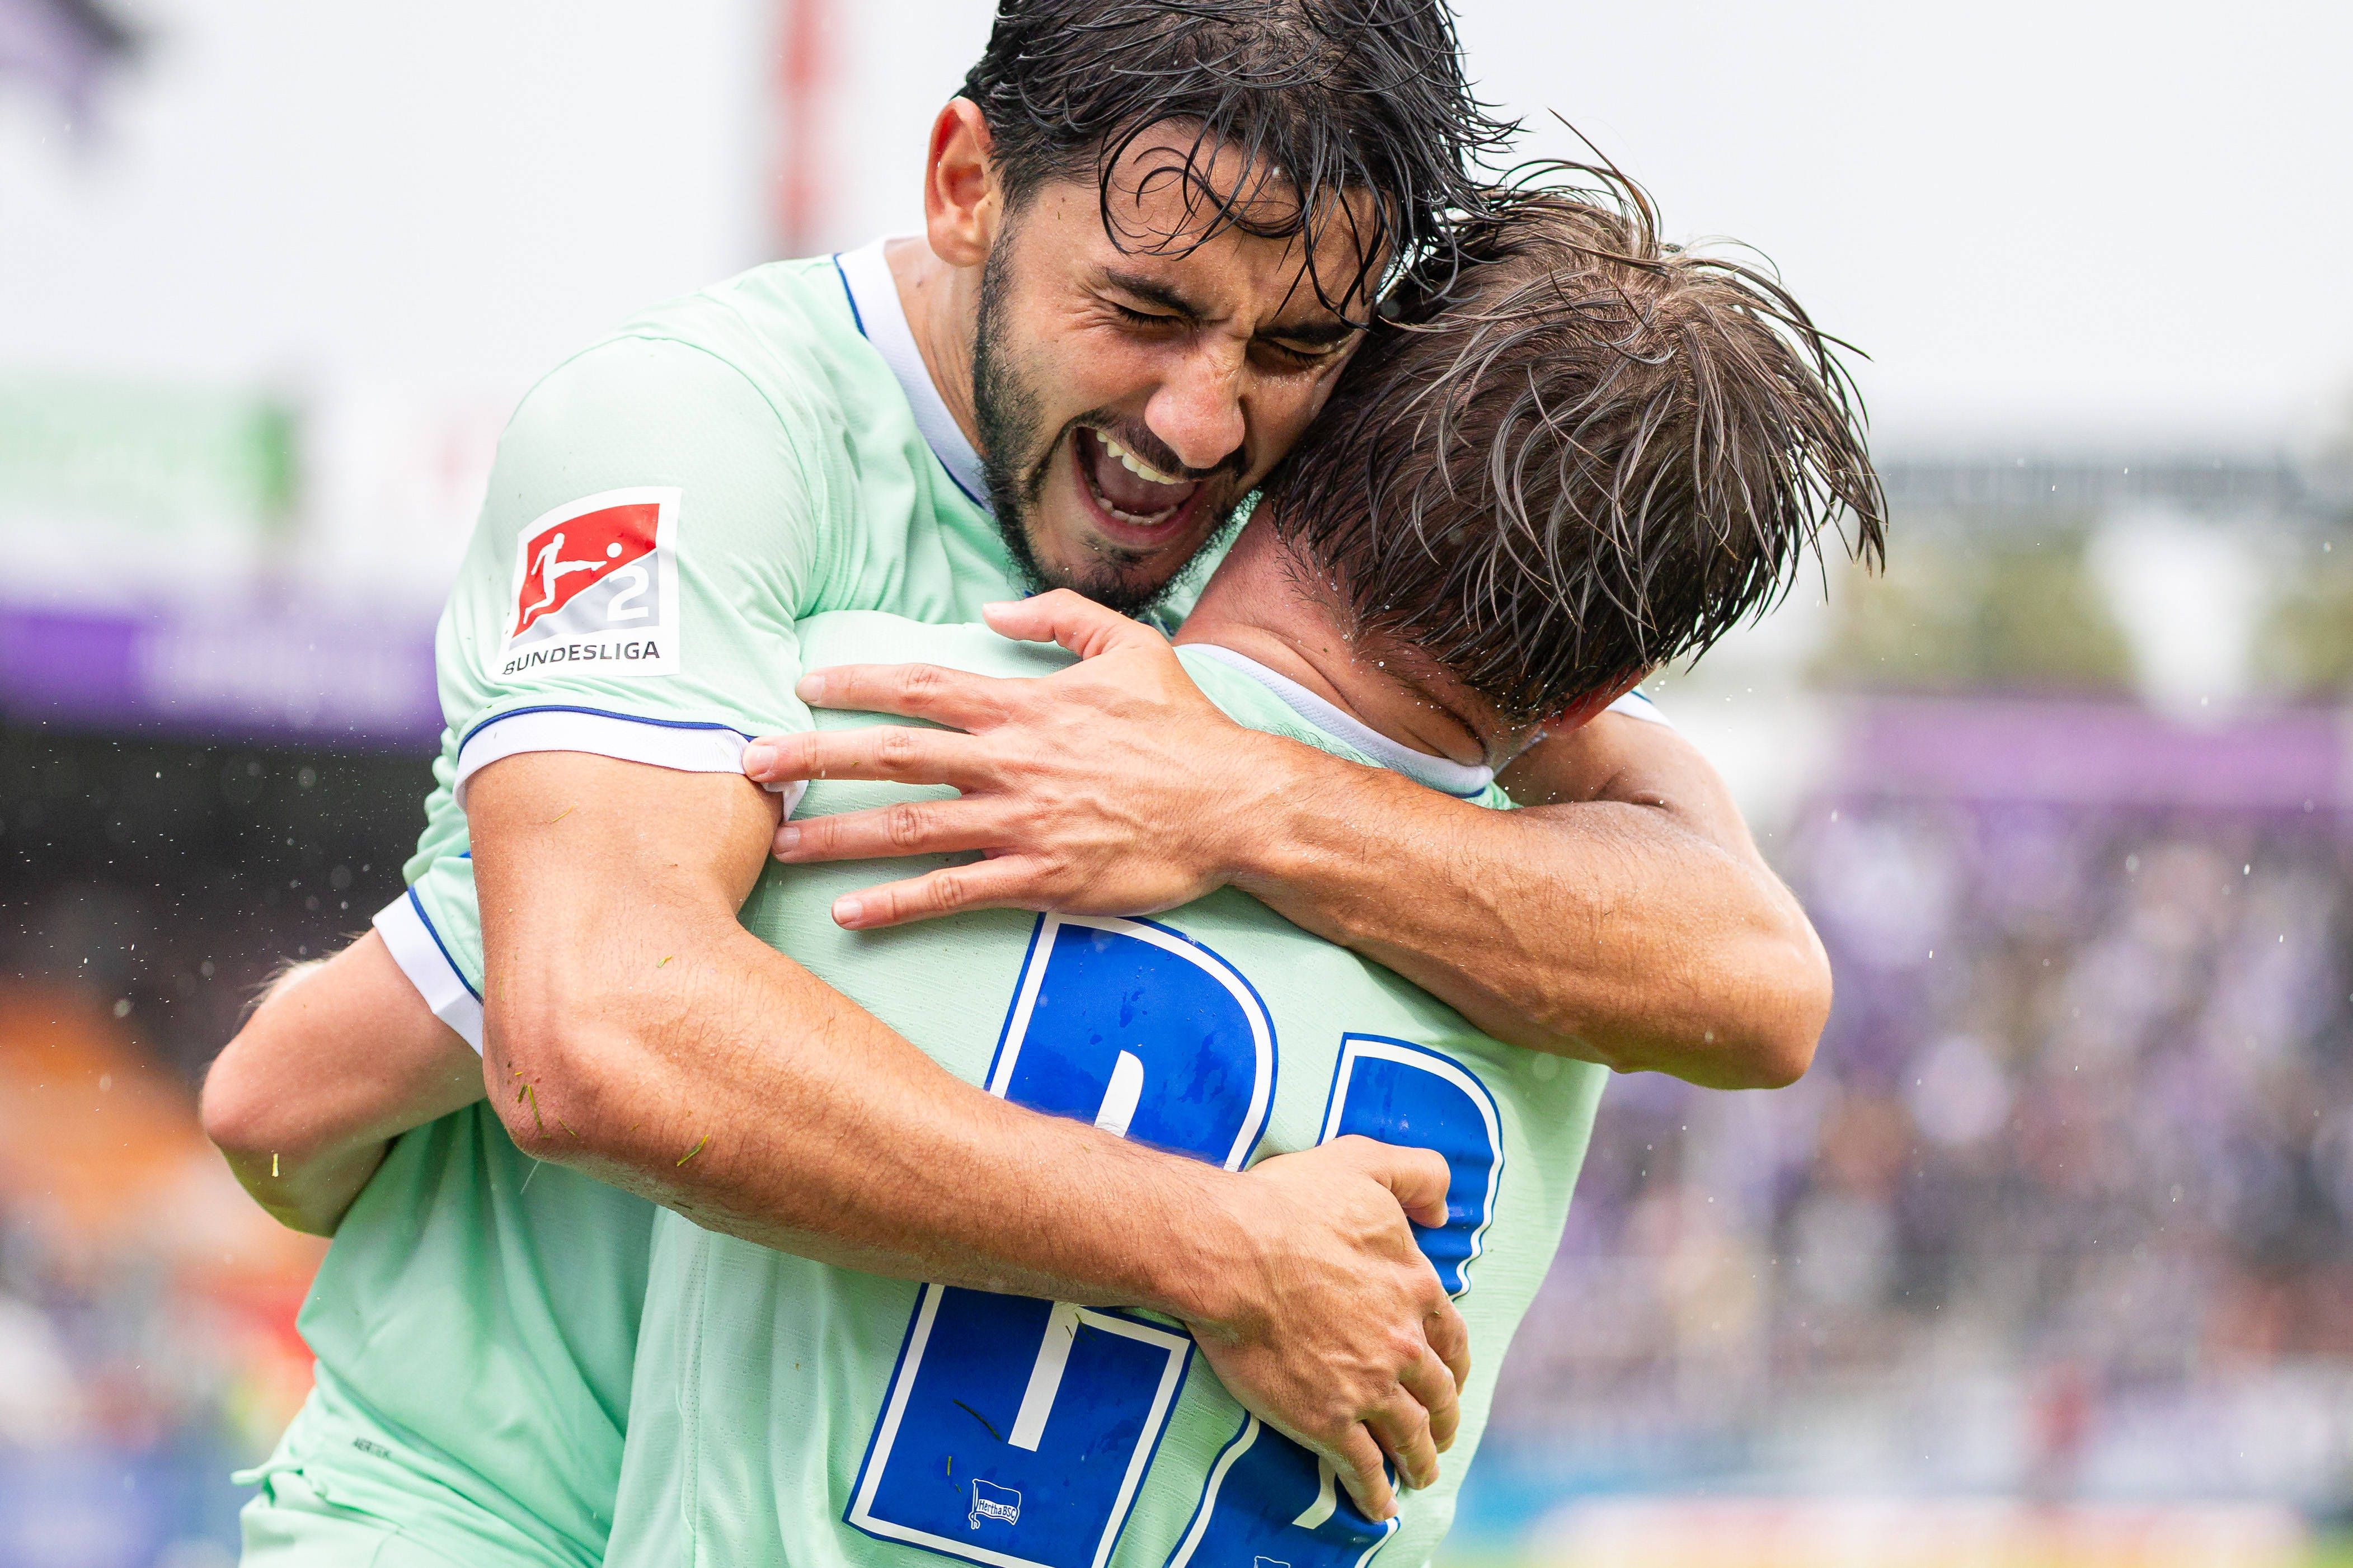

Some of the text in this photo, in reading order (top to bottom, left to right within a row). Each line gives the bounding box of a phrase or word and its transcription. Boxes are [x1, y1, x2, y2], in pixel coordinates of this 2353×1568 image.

[607, 564, 649, 622] 2
[502, 641, 660, 675] BUNDESLIGA
[979, 1500, 1016, 1519] Hertha BSC
